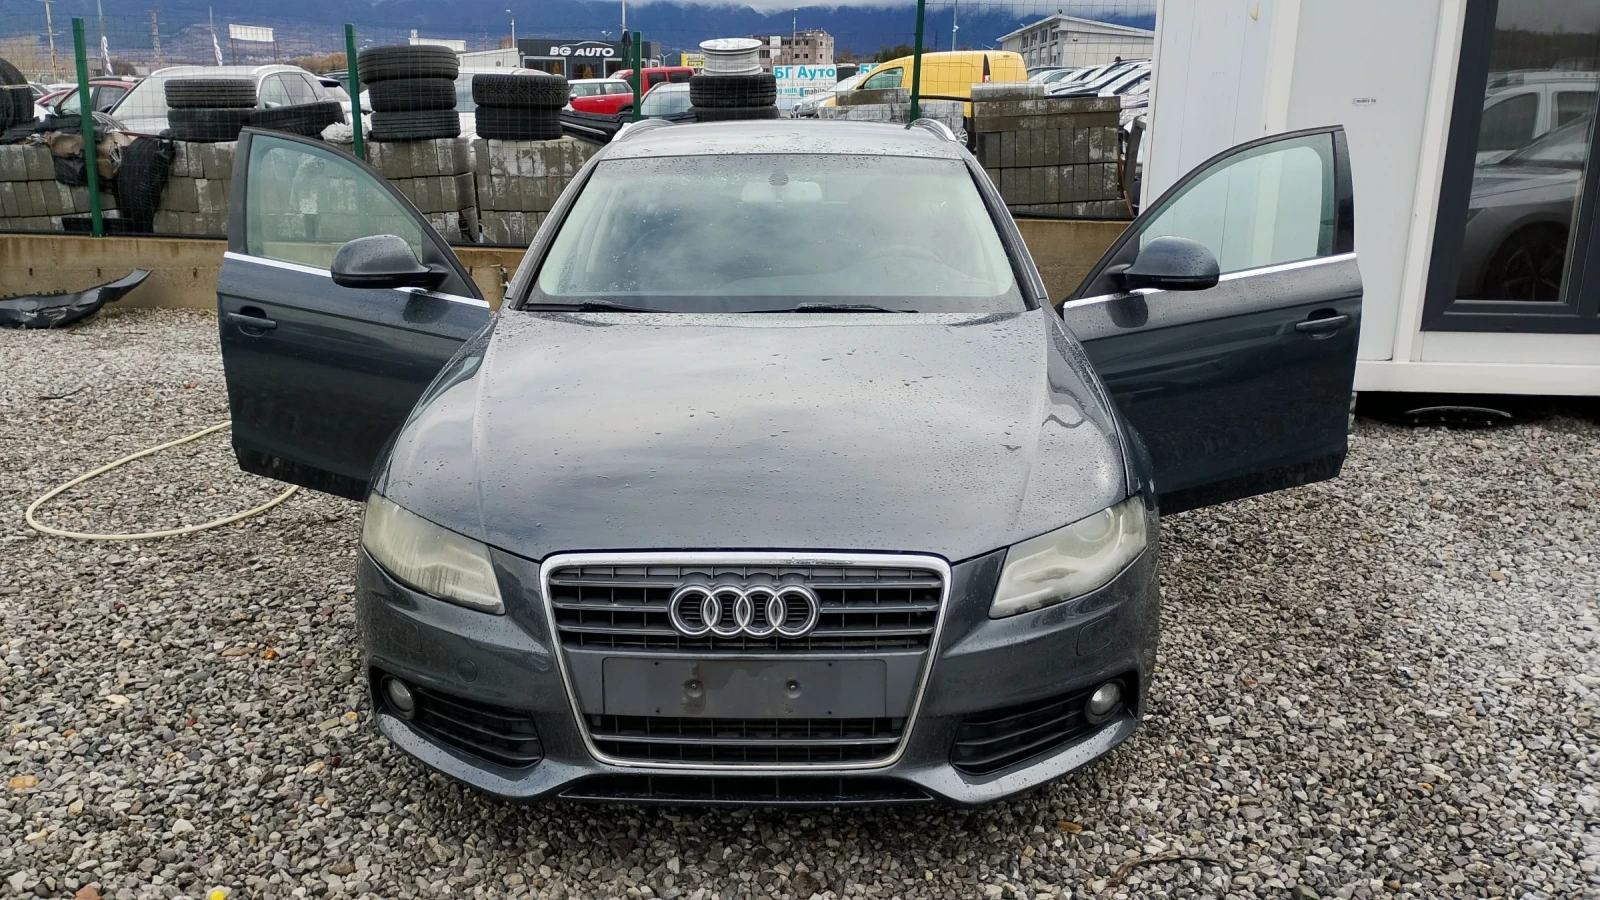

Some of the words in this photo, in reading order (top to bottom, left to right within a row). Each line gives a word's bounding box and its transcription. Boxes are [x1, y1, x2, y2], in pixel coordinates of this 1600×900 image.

[549, 46, 571, 56] BG
[573, 47, 615, 57] AUTO
[774, 66, 793, 79] БГ
[797, 66, 835, 81] Ауто
